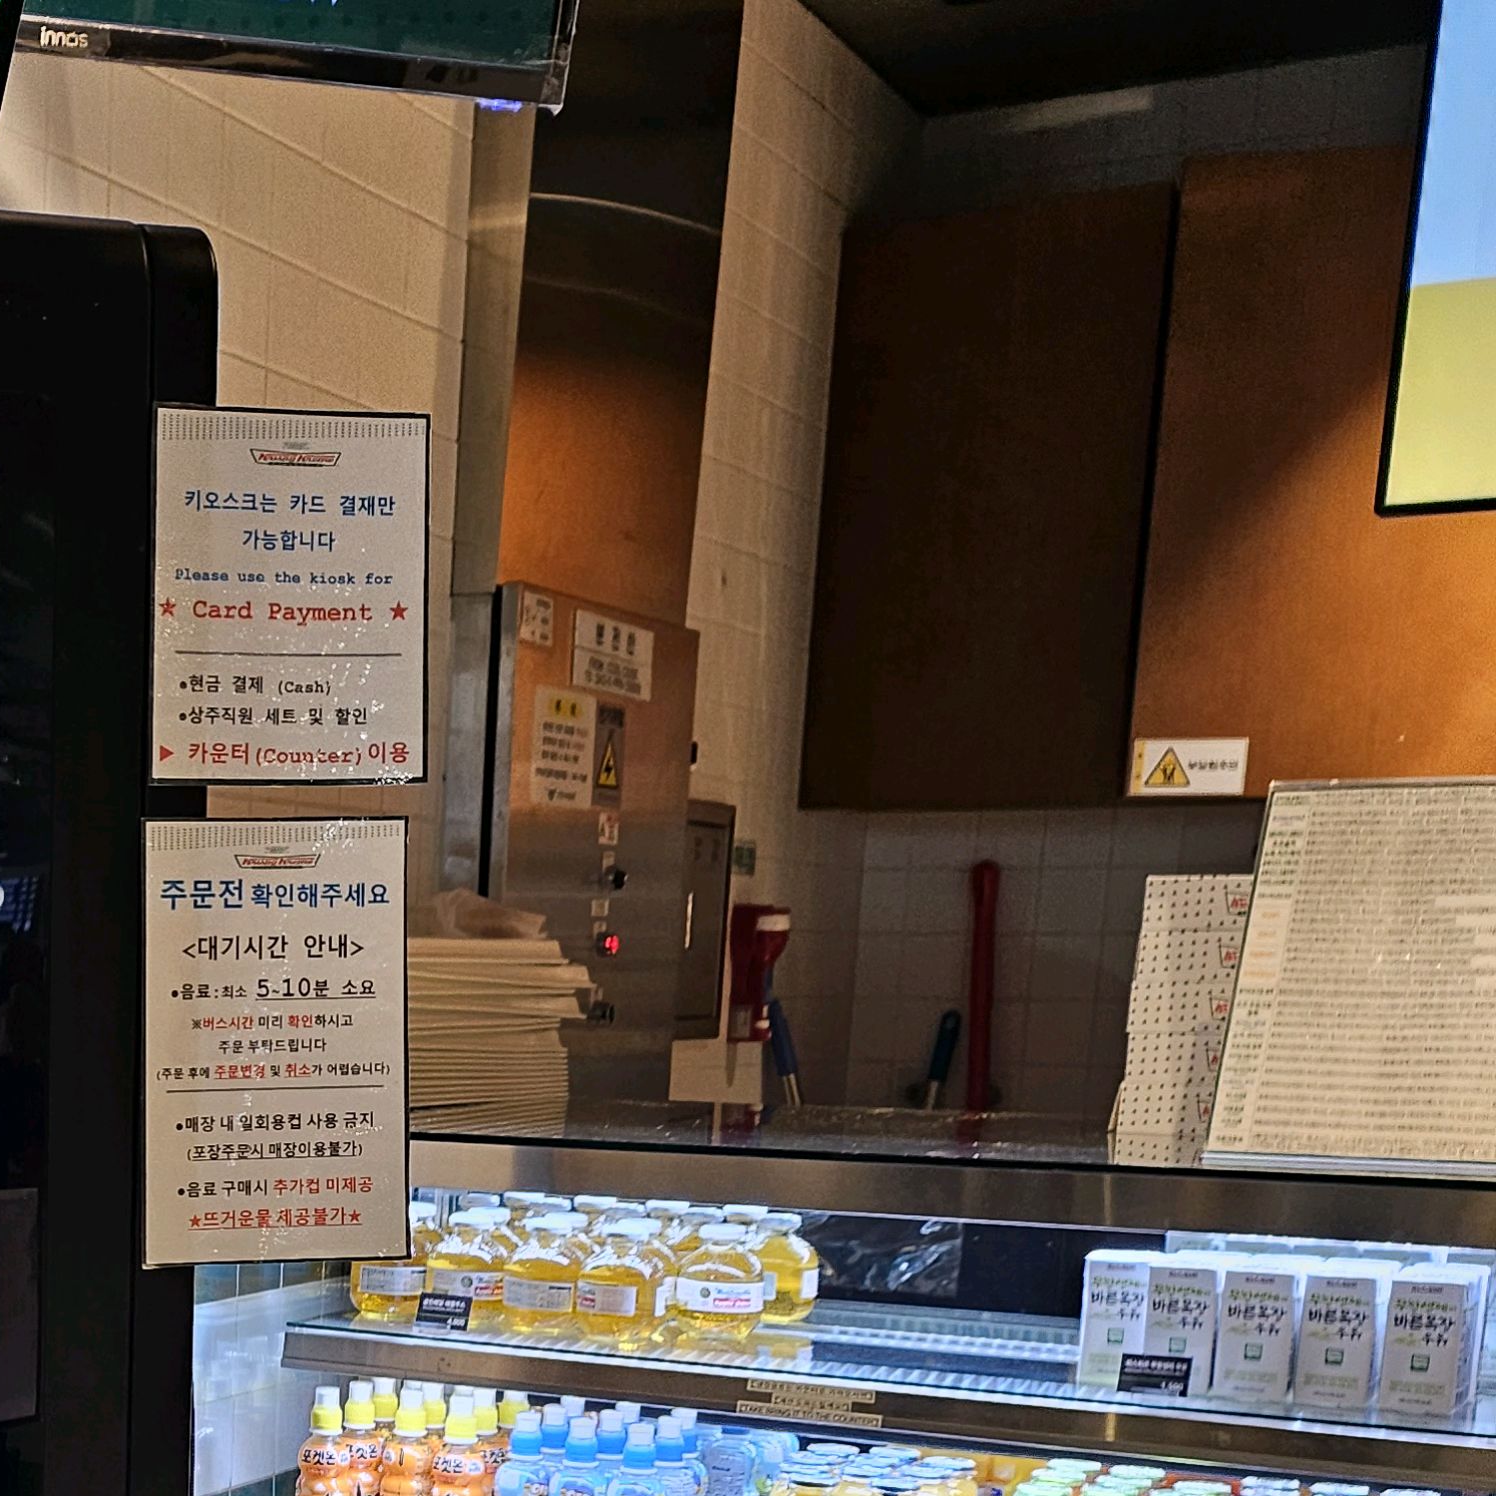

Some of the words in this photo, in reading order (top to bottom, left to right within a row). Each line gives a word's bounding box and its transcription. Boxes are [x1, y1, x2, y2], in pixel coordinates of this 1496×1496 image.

[184, 490, 278, 514] 키오스크는
[290, 494, 327, 515] 카드
[339, 495, 396, 517] 결재만
[242, 530, 336, 553] 가능합니다
[175, 568, 229, 582] Please
[238, 573, 265, 583] use
[275, 571, 301, 584] the
[309, 572, 356, 585] kiosk
[364, 572, 393, 585] for
[192, 600, 253, 620] Card
[268, 602, 373, 626] Payment
[188, 675, 221, 694] 현금
[232, 676, 264, 695] 결제
[277, 680, 332, 696] (Cash)
[188, 707, 253, 726] 상주직원
[265, 708, 298, 725] 세트
[309, 708, 324, 726] 및
[335, 708, 368, 725] 할인
[160, 878, 244, 910] 주문전
[251, 881, 390, 908] 확인해주세요
[256, 977, 330, 999] 5~10분
[341, 978, 376, 998] 소요
[258, 1014, 283, 1030] 미리
[287, 1012, 353, 1029] 확인하시고
[218, 1040, 244, 1055] 주문
[247, 1037, 327, 1054] 부탁드립니다
[157, 1065, 184, 1081] (주문
[187, 1065, 210, 1079] 후에
[213, 1063, 266, 1079] 주문변경
[269, 1064, 282, 1078] 및
[284, 1062, 323, 1079] 취소가
[184, 1115, 215, 1133] 매장
[220, 1114, 235, 1133] 내
[239, 1113, 302, 1132] 일회용컵
[306, 1112, 338, 1130] 사용
[342, 1111, 375, 1129] 금지
[186, 1143, 264, 1163] (포장주문시
[268, 1141, 363, 1160] 매장이용불가)
[186, 1180, 217, 1197] 음료
[221, 1179, 269, 1197] 구매시
[273, 1178, 320, 1195] 추가컵
[325, 1175, 373, 1194] 미제공
